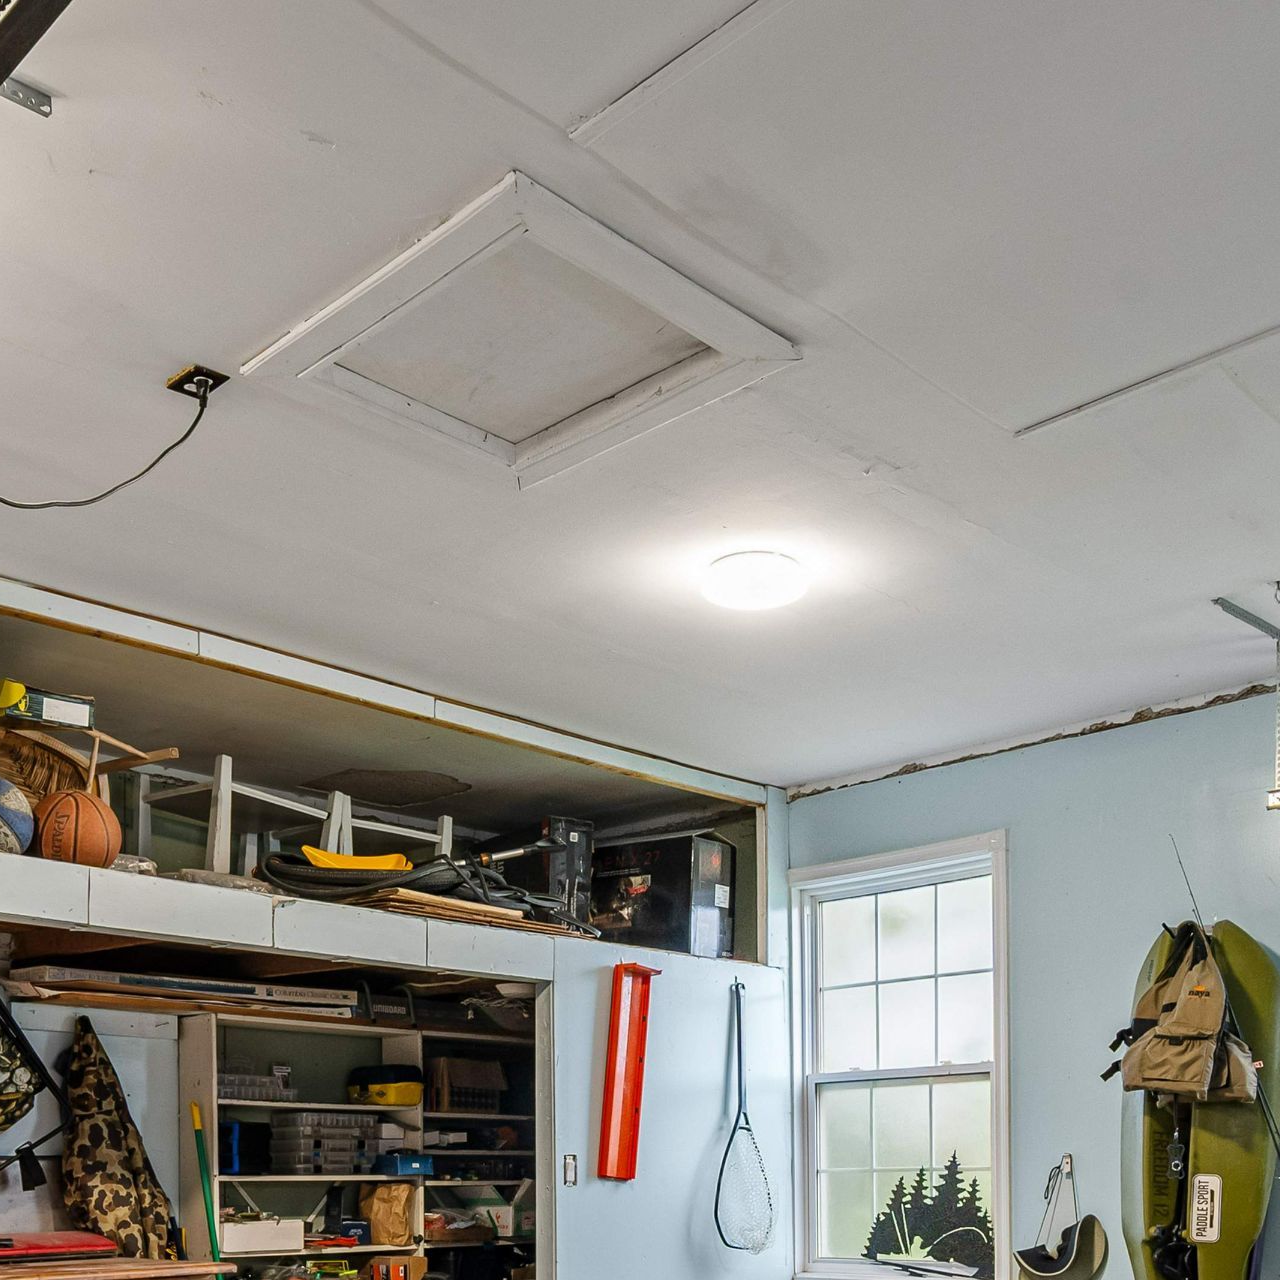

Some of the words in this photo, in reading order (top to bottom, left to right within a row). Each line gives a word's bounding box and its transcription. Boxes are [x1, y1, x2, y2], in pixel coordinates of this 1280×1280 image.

[1188, 989, 1211, 998] naya
[373, 1004, 407, 1015] UNIBOARD
[1197, 1180, 1210, 1206] SPORT
[1195, 1206, 1209, 1237] PADDLE
